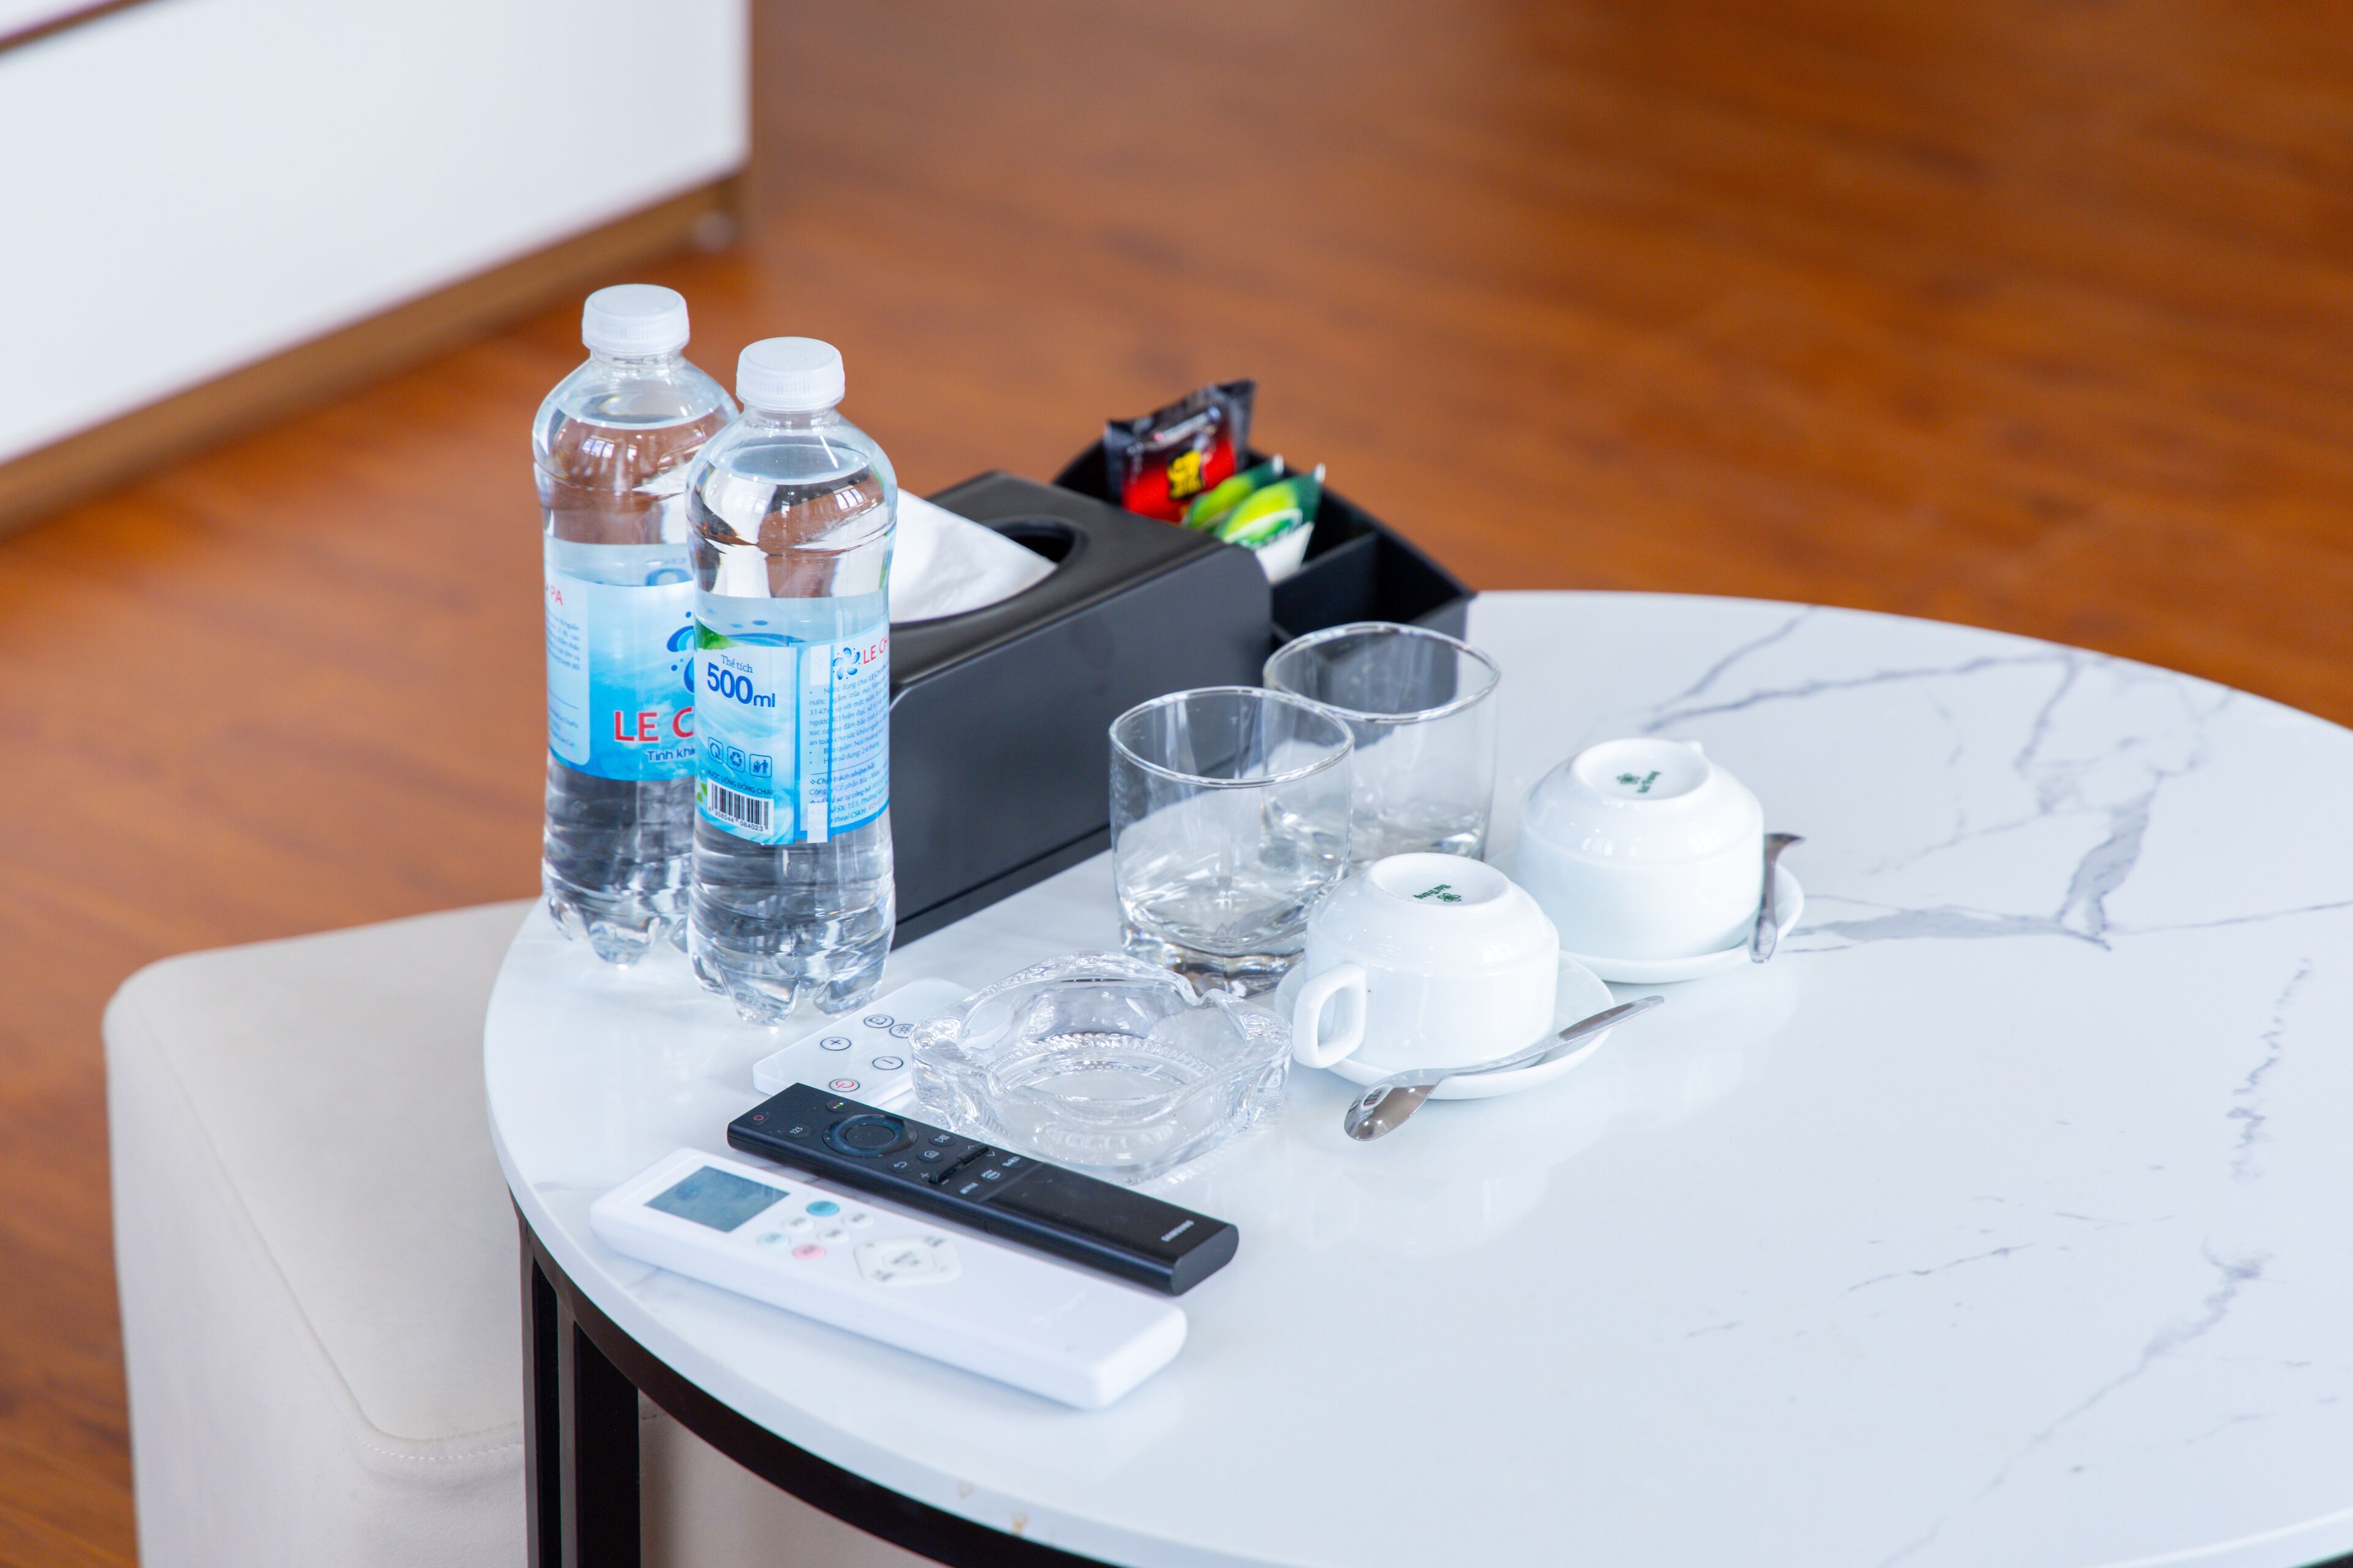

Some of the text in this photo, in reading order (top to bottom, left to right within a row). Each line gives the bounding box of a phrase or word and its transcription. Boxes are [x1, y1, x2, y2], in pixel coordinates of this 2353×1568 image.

[863, 645, 876, 664] LE
[707, 661, 776, 708] 500ml
[614, 710, 659, 741] LE
[740, 820, 763, 832] 064023
